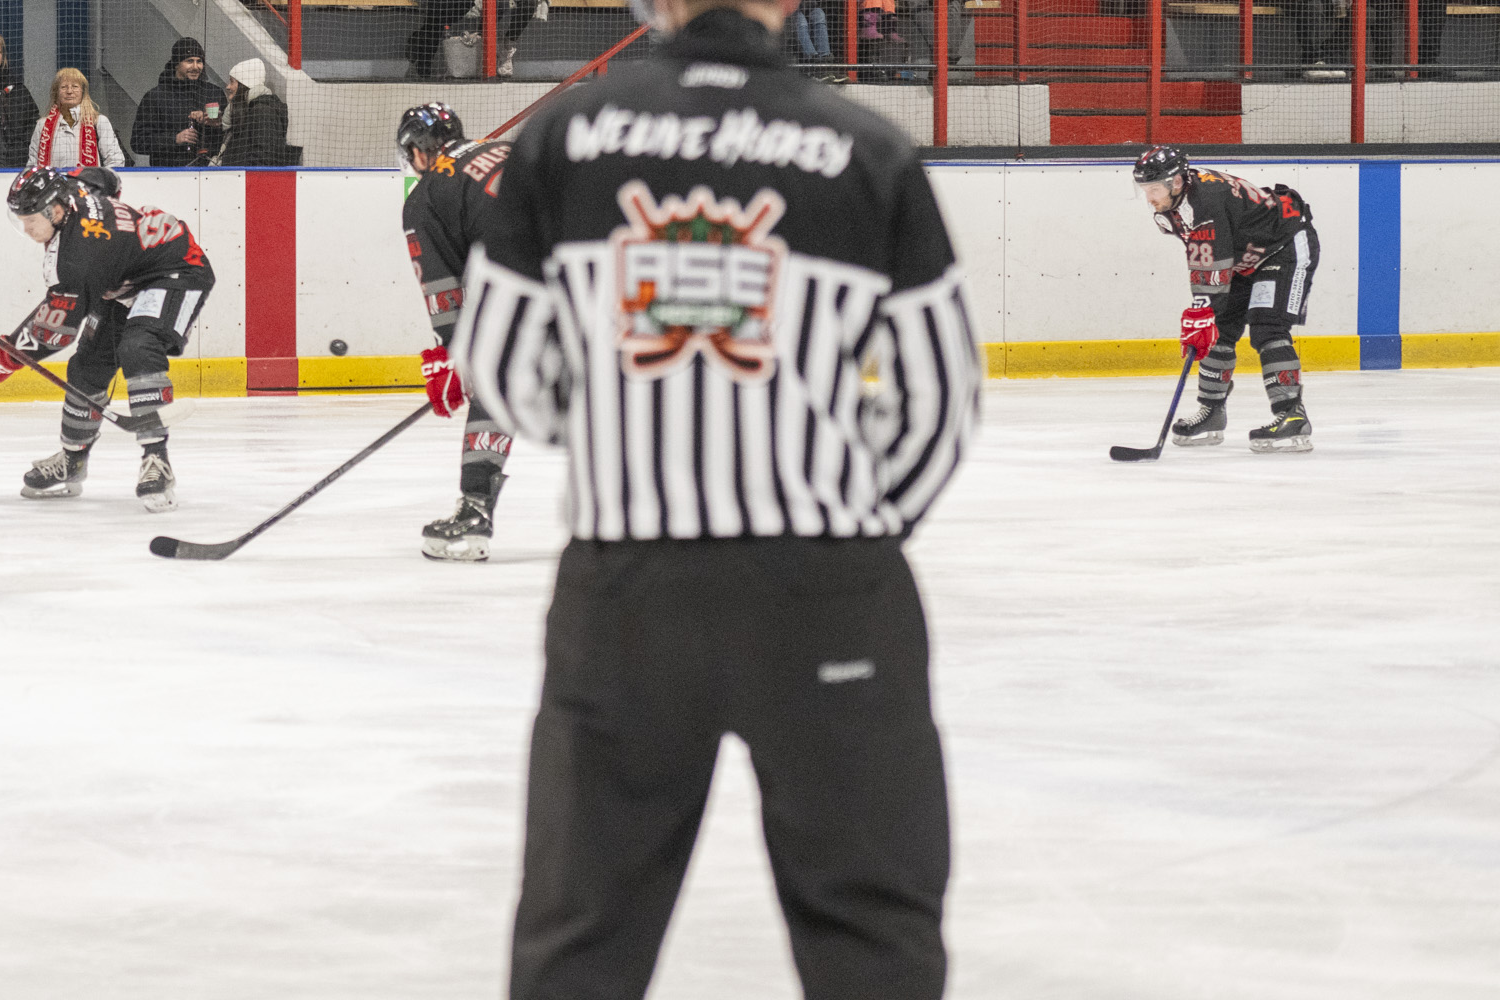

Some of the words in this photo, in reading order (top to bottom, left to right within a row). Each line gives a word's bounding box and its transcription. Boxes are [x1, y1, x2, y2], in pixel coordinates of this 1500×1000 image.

[1188, 242, 1214, 267] 28
[1182, 316, 1216, 329] CCM
[421, 359, 455, 376] CM
